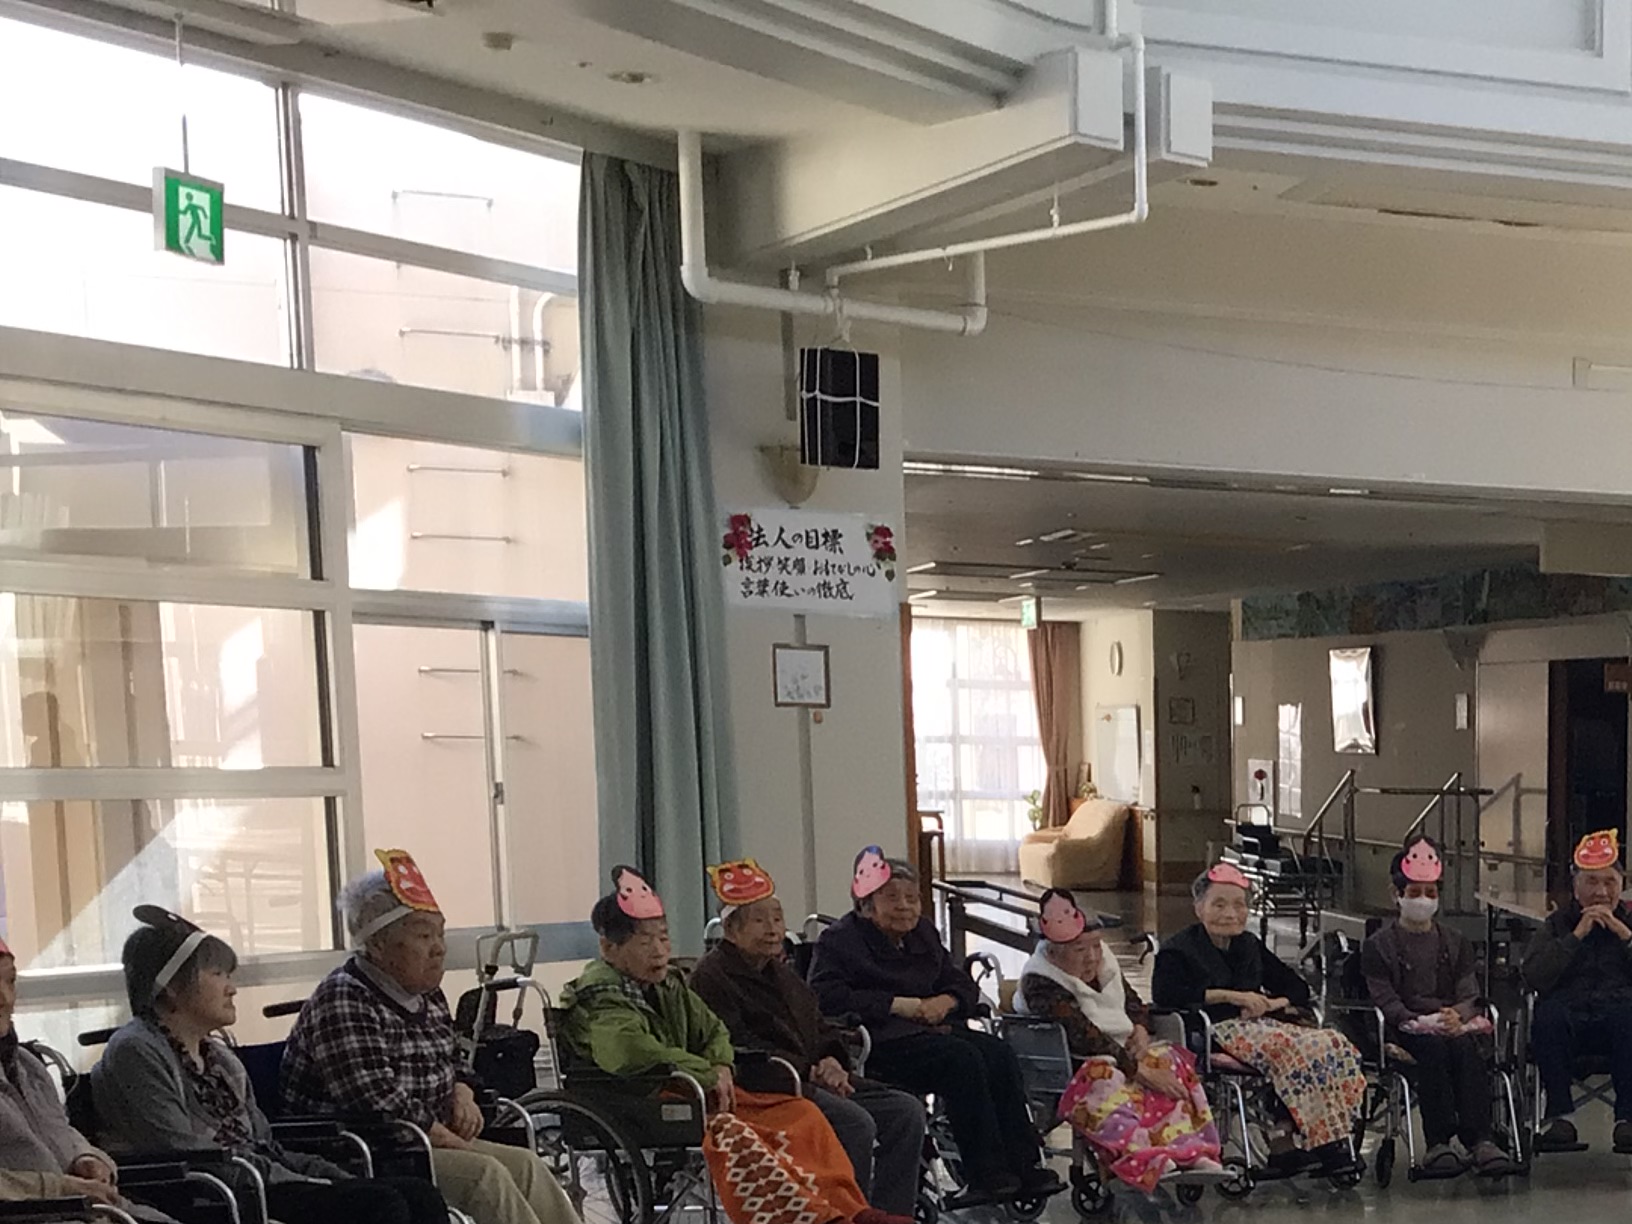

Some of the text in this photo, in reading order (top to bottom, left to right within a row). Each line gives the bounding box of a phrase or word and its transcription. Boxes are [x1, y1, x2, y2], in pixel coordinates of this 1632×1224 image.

[748, 525, 844, 555] 法人の目標
[740, 578, 854, 601] 言葉使いの徹底
